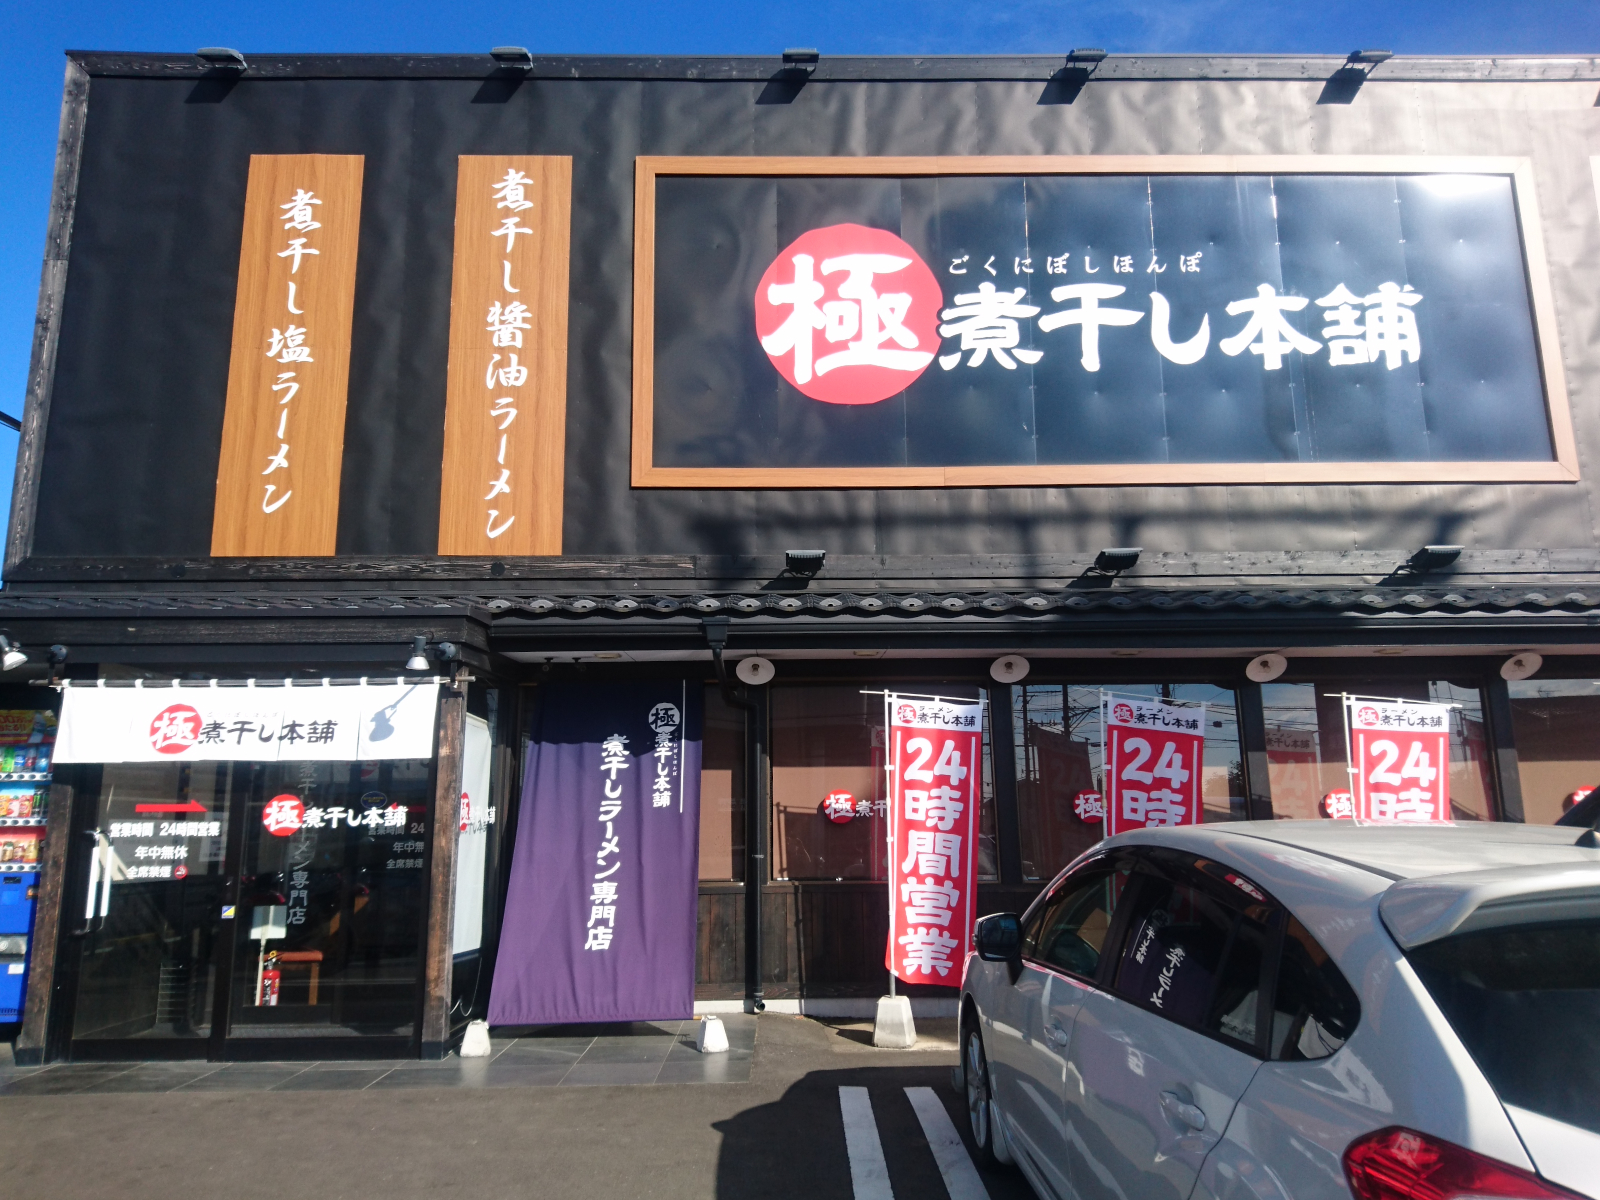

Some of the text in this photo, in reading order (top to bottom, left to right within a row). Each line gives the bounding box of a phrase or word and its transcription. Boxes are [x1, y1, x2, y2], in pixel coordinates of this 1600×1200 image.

[948, 252, 1202, 276] ごくにぼしほんぽ
[262, 188, 323, 514] 煮干し塩ラーメン
[919, 705, 954, 714] ラーメン
[1136, 705, 1174, 714] ラーメン
[1381, 707, 1418, 715] ラーメン
[585, 733, 630, 951] 煮干しラーメン専門店
[135, 845, 188, 860] 年中無休
[900, 737, 968, 977] 24時間営業
[127, 865, 171, 878] 全席禁煙
